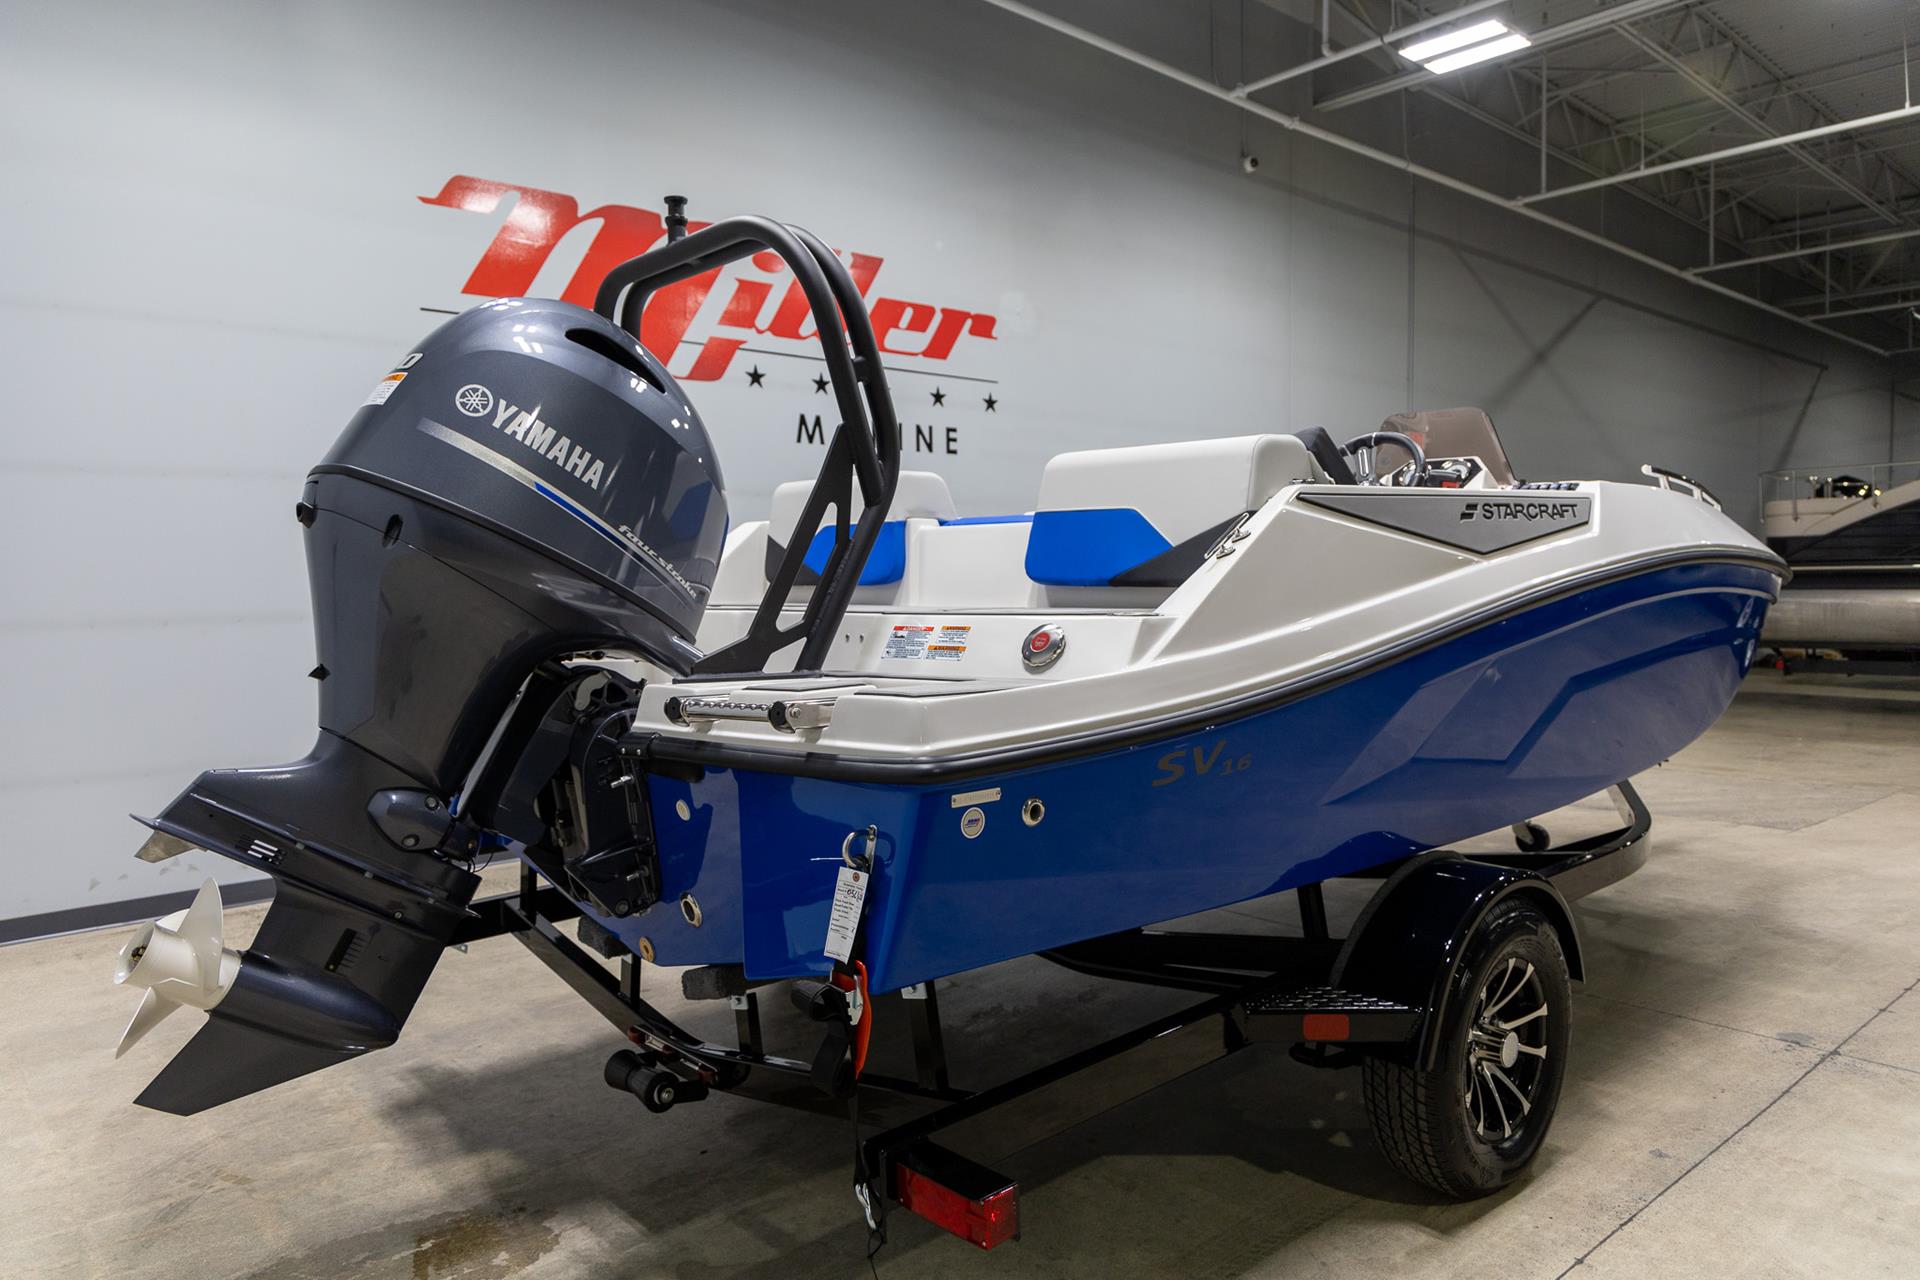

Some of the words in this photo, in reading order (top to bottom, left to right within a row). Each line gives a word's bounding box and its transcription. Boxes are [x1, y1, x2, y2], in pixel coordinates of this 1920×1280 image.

[490, 398, 606, 491] YAMAHA
[796, 413, 958, 455] MINE
[1482, 503, 1578, 521] STARCRAFT
